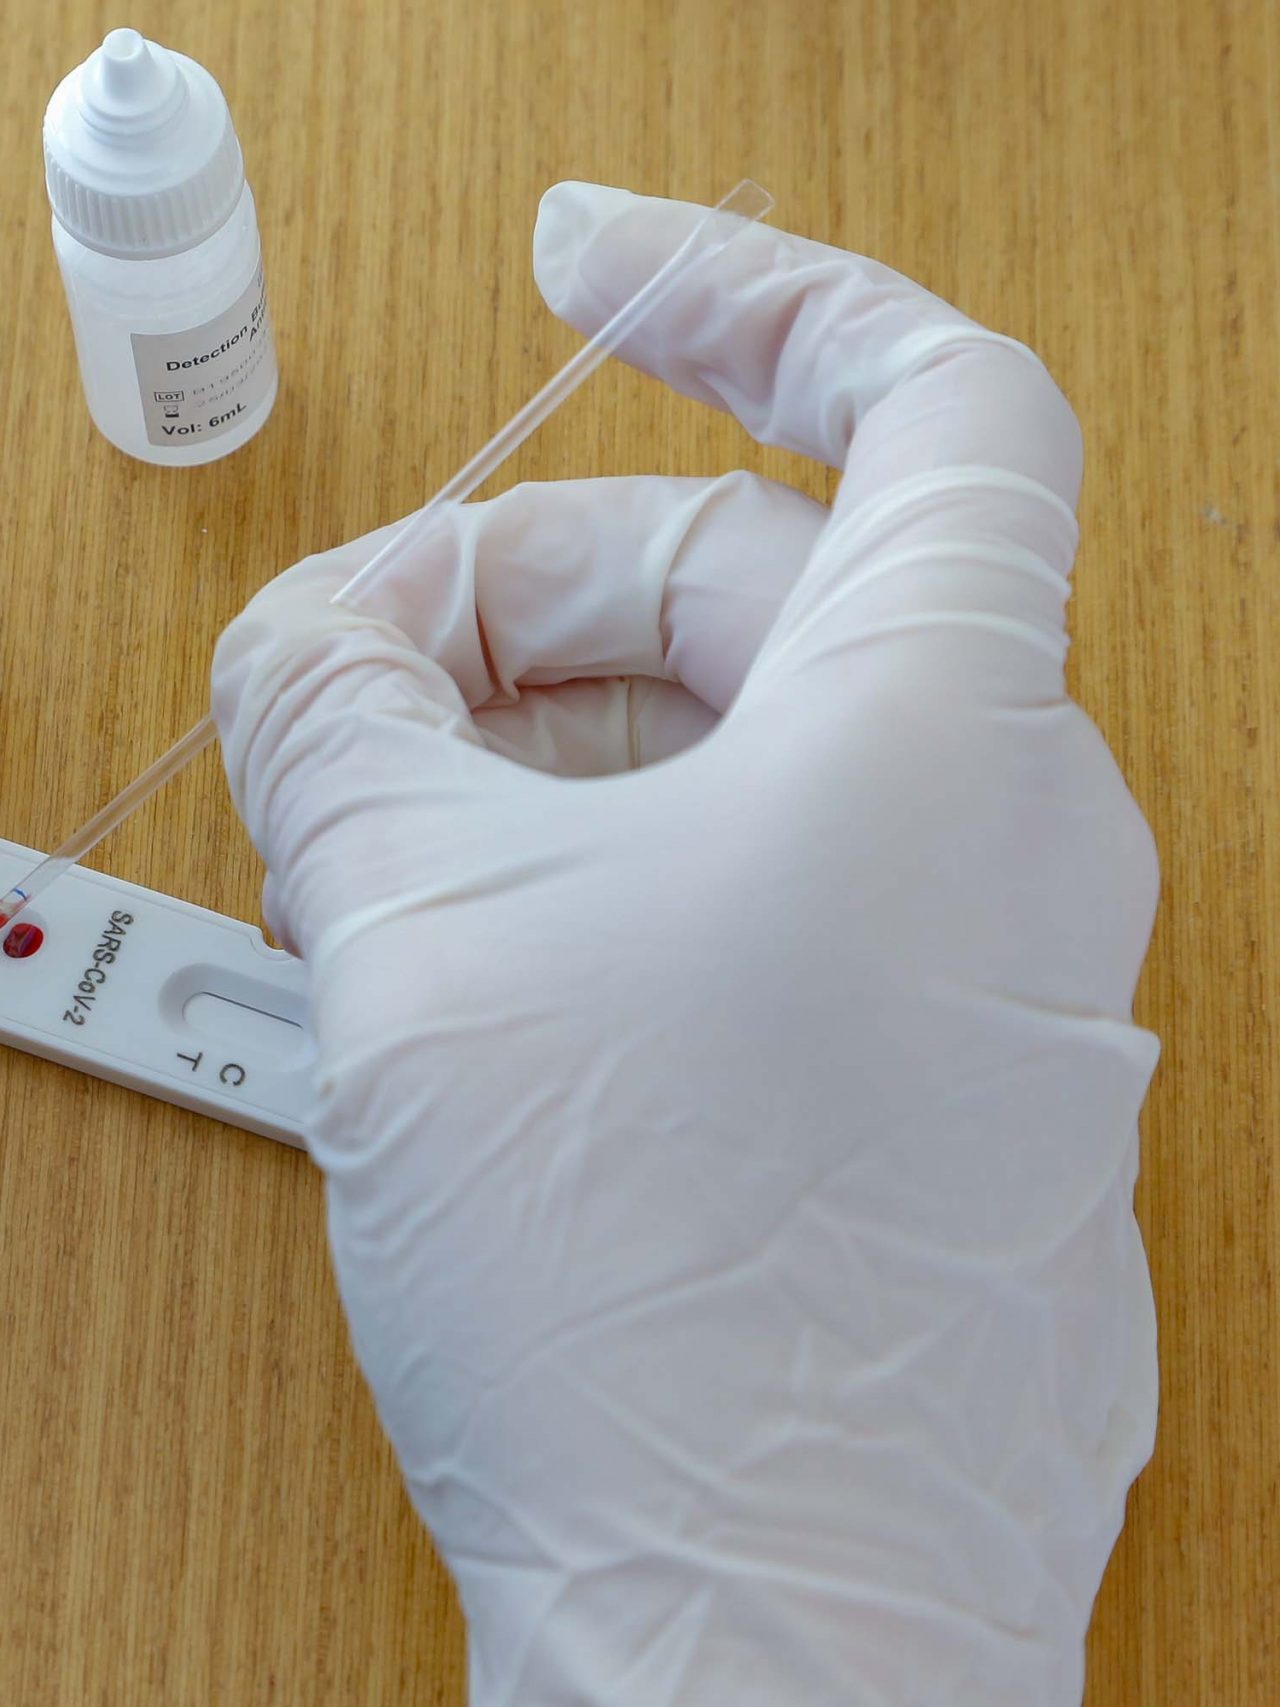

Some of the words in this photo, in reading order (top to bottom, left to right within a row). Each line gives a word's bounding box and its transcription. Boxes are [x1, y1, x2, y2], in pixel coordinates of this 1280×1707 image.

[166, 326, 248, 371] Detection
[157, 392, 182, 402] LOT
[162, 423, 202, 435] Vol:
[209, 403, 247, 428] 6mL
[63, 910, 134, 1026] SARS-CoV-2
[176, 1051, 203, 1072] T
[219, 1063, 246, 1087] C
